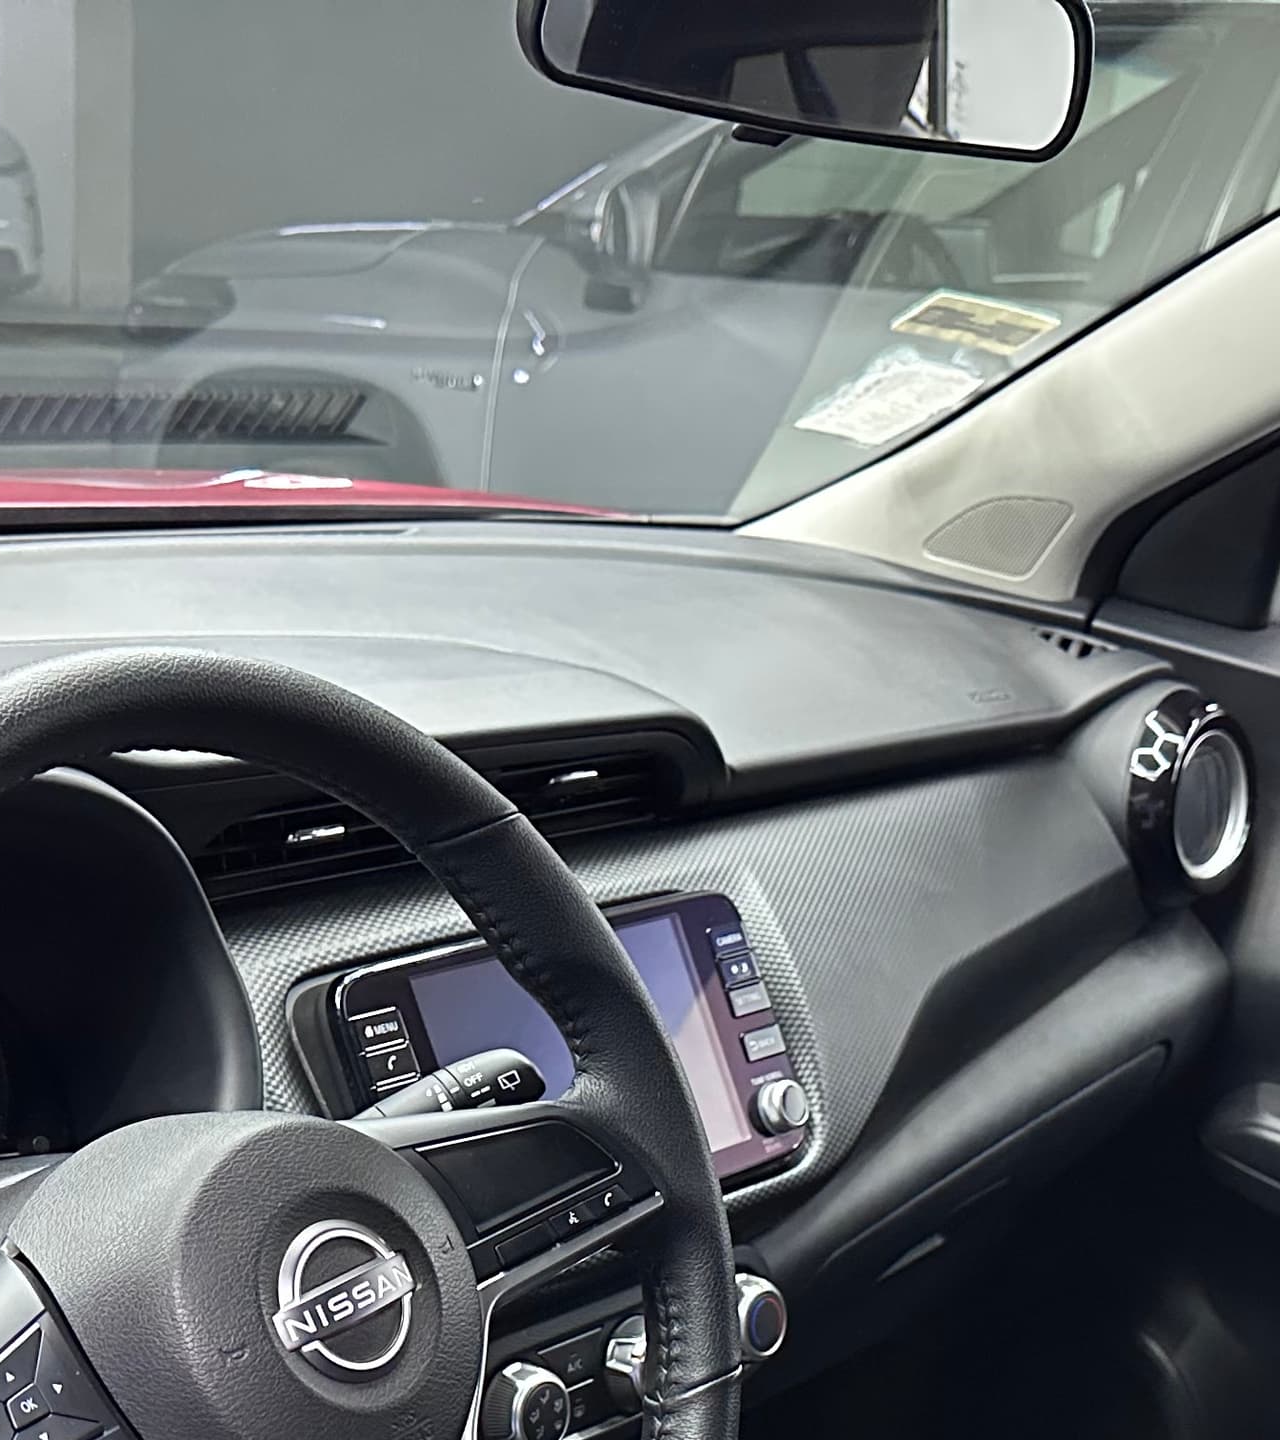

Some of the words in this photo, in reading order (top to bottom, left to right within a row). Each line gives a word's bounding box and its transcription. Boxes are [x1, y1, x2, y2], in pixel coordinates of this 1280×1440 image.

[373, 1020, 399, 1036] MENU
[463, 1072, 484, 1088] OFF
[285, 1261, 413, 1342] NISSAN
[20, 1396, 39, 1414] OK
